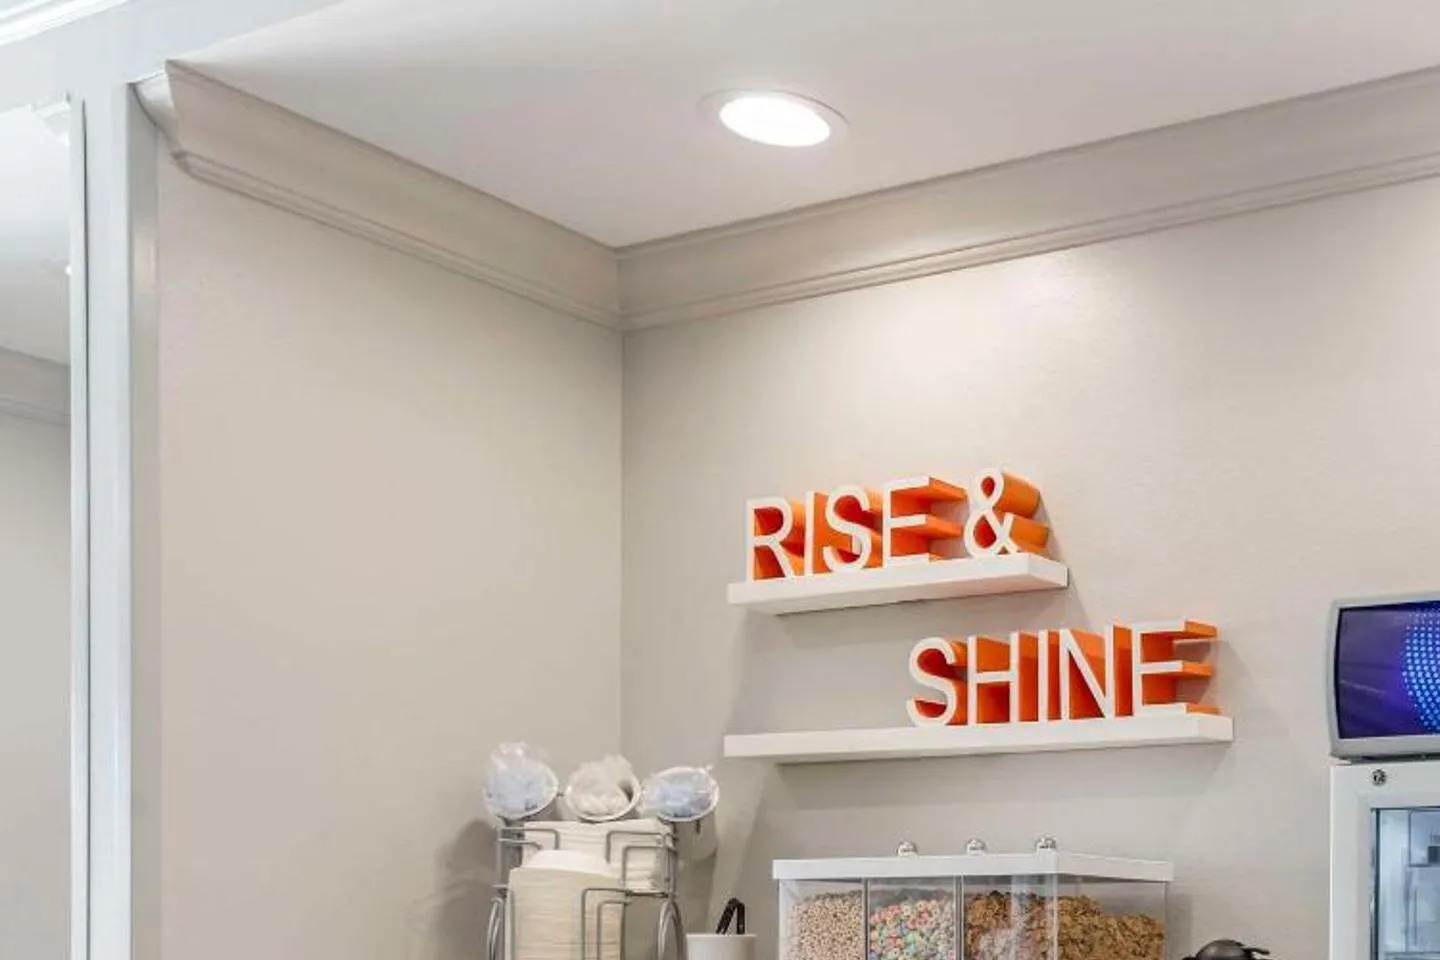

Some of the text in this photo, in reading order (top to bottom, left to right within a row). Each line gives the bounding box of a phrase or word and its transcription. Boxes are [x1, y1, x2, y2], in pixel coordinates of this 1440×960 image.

[746, 467, 1021, 582] RISE &
[906, 620, 1192, 727] SHINE
